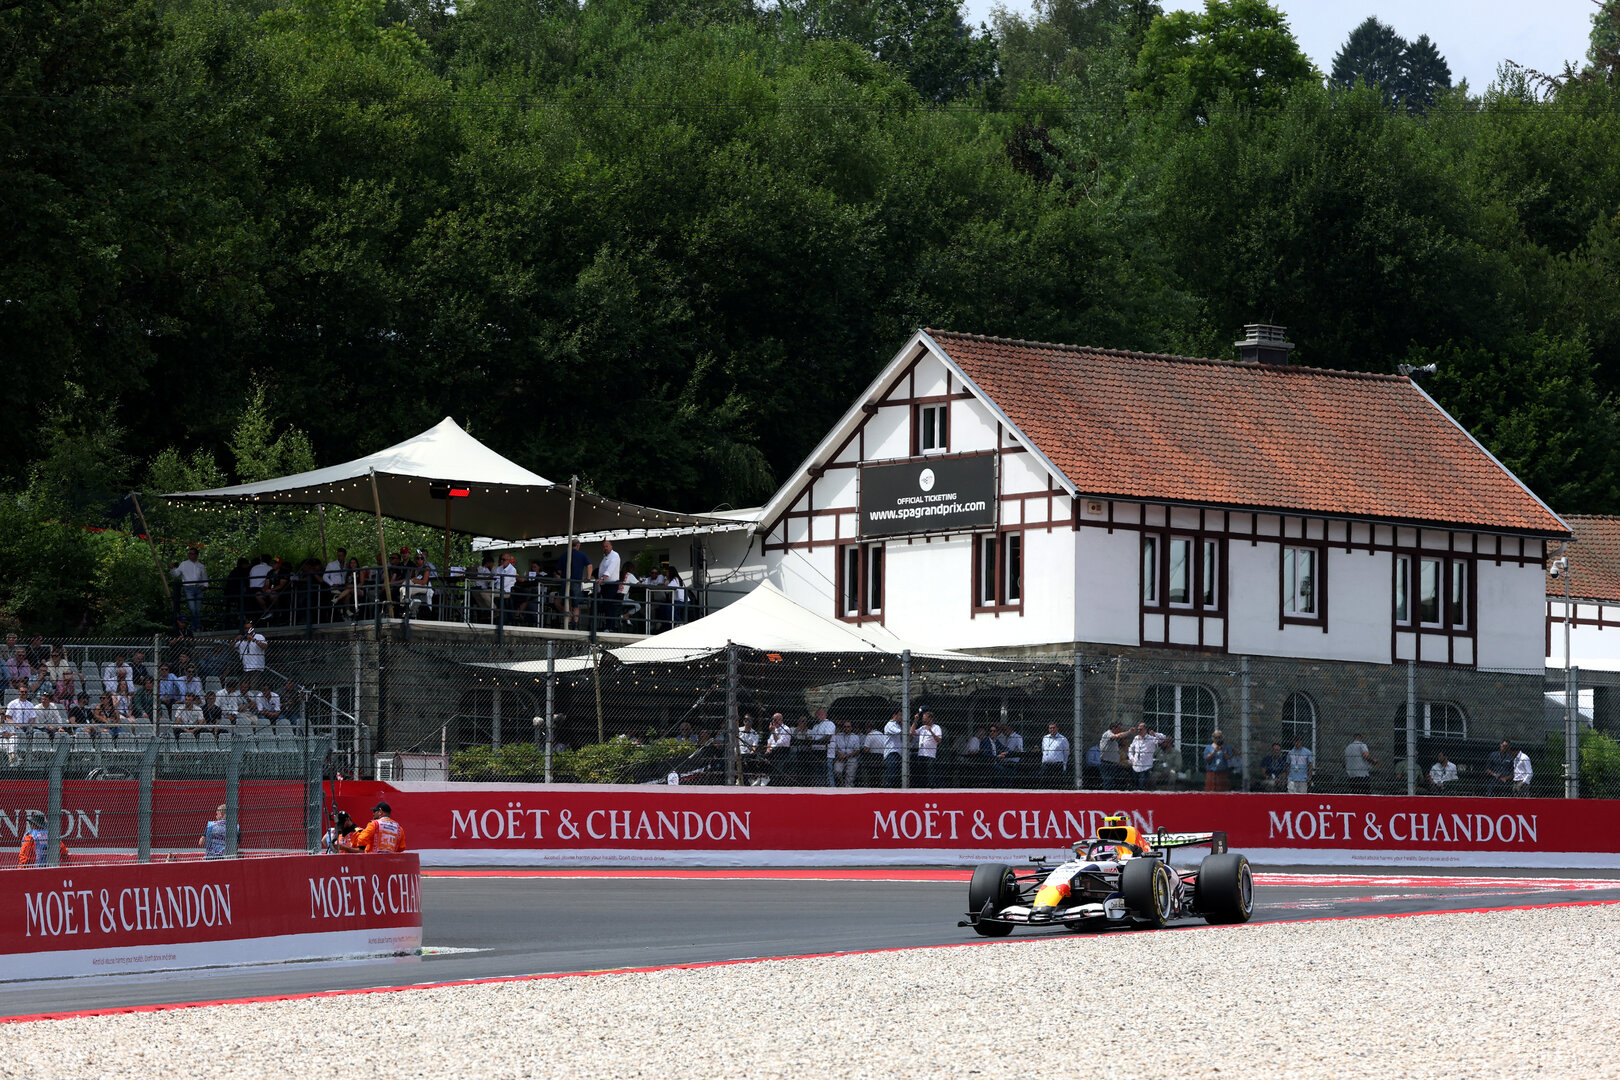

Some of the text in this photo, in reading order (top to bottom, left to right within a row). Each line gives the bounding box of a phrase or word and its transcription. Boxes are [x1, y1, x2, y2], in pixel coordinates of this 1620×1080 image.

[869, 501, 986, 521] www.spagrandprix.com
[897, 492, 957, 506] OFFICIAL TICKETING
[450, 802, 752, 841] MOËT & CHANDON
[872, 803, 964, 840] MOËT
[971, 809, 993, 840] &
[1269, 804, 1538, 843] MOËT & CHANDON
[25, 880, 232, 937] MOËT & CHANDON
[309, 866, 366, 919] MOËT
[371, 873, 386, 915] &
